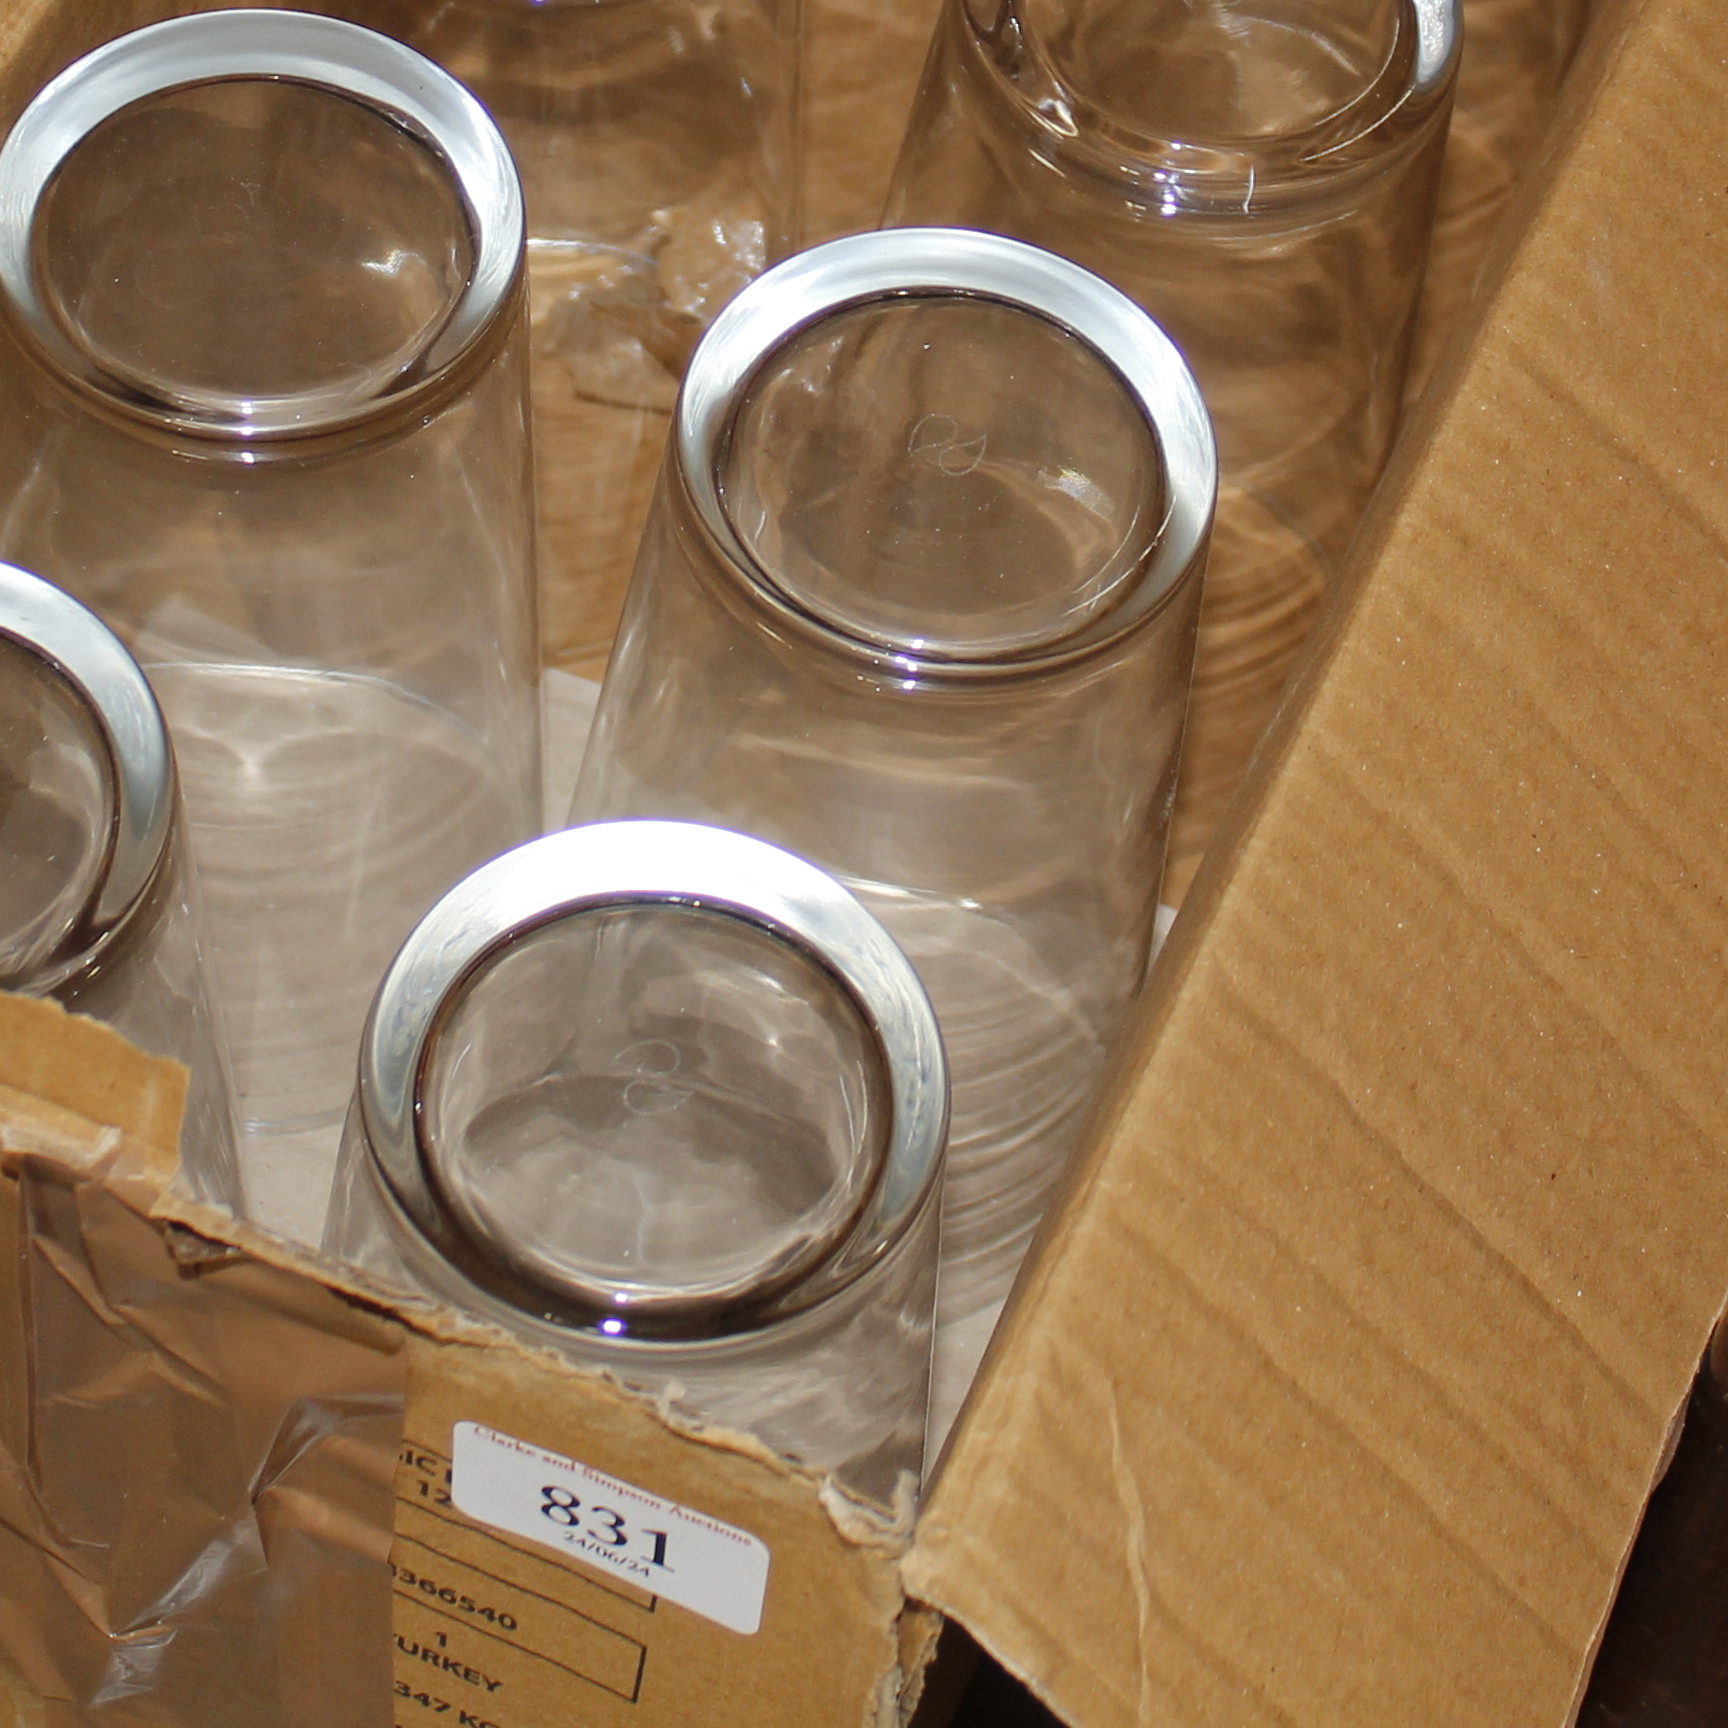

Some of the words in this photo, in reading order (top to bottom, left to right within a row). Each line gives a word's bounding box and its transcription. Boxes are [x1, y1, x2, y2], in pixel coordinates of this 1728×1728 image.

[399, 1450, 437, 1476] IC
[474, 1424, 536, 1457] Clarke
[542, 1456, 576, 1472] and
[582, 1467, 662, 1510] Simpson
[669, 1503, 752, 1547] Auctions
[541, 1485, 675, 1574] 831
[564, 1530, 650, 1578] 24/06/24
[393, 1633, 504, 1693] URKEY
[435, 1631, 448, 1648] 1
